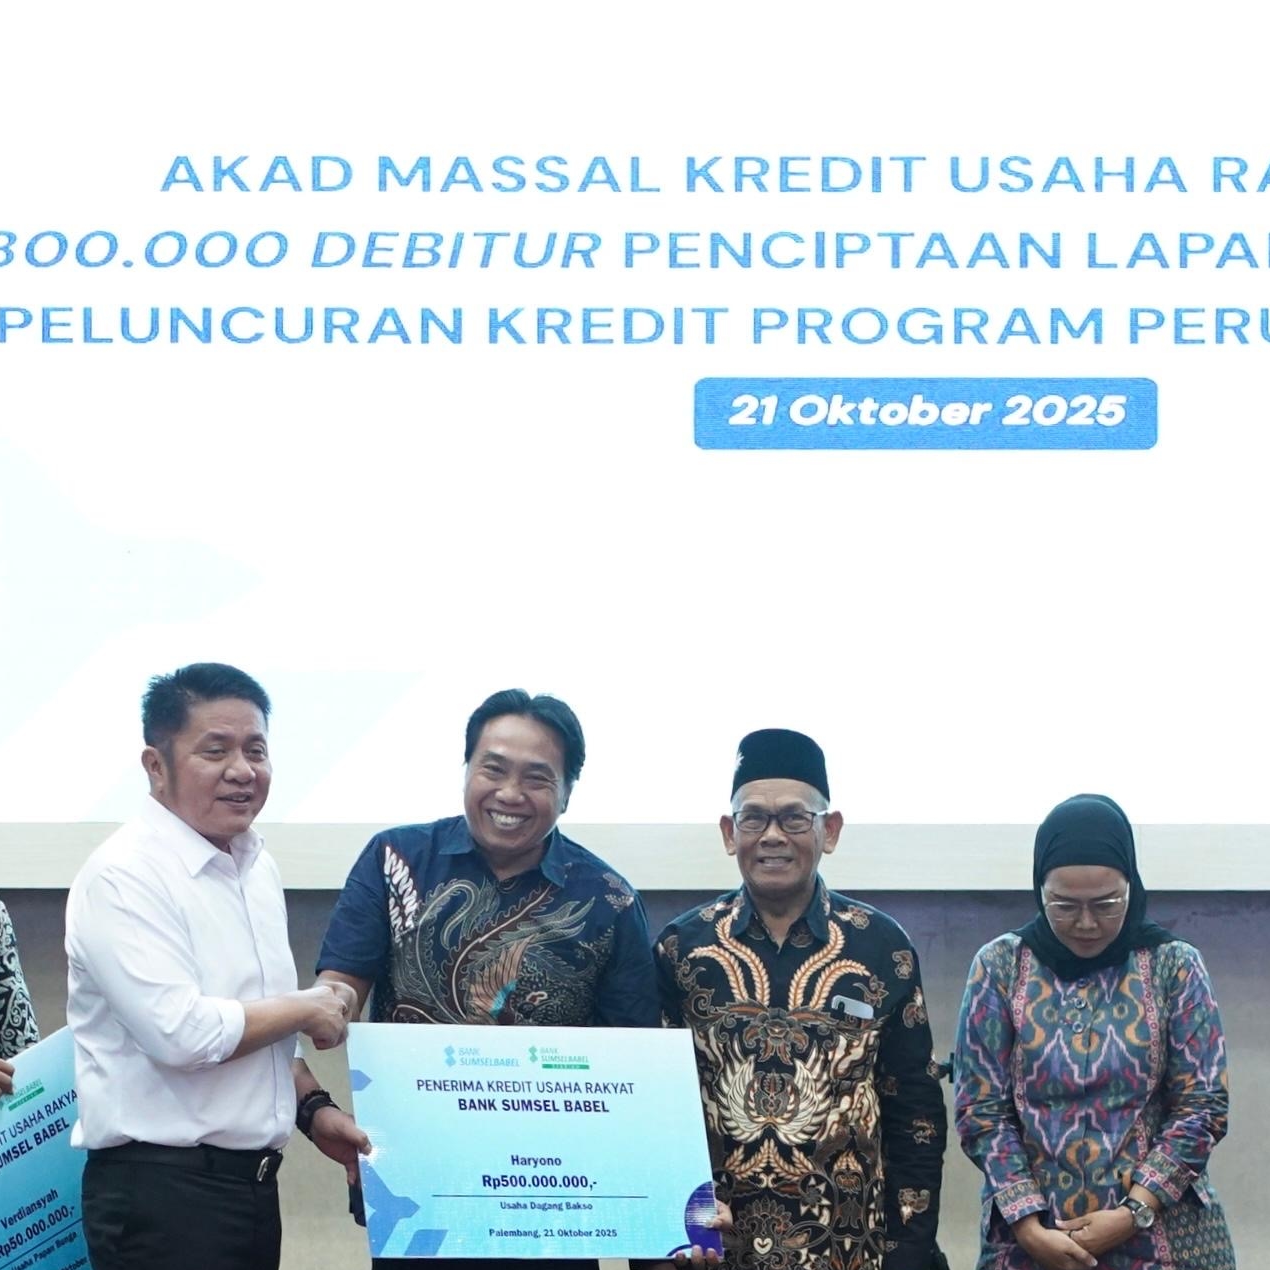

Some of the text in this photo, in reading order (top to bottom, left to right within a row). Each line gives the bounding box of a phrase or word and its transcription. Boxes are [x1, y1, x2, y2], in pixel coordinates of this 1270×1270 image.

[159, 155, 354, 194] AKAD
[376, 155, 662, 194] MASSAL
[685, 155, 928, 194] KREDIT
[949, 155, 1189, 194] USAHA
[309, 230, 603, 270] DEBITUR
[623, 230, 1062, 270] PENCIPTAAN
[487, 306, 730, 346] KREDIT
[751, 306, 1105, 346] PROGRAM
[728, 393, 1128, 427] 21 Oktober 2025
[416, 1079, 635, 1095] PENERIMA KREDIT USAHA RAKYAT
[9, 1109, 45, 1139] USAHA
[44, 1088, 78, 1117] RAKYA
[457, 1098, 610, 1113] BANK SUMSEL BABEL
[33, 1117, 70, 1147] BABEL
[510, 1155, 563, 1168] Haryono
[481, 1174, 598, 1191] Rp500.000.000,-
[0, 1188, 59, 1230] Verdiansyah
[500, 1201, 593, 1211] Usaha Dagang Bakso
[489, 1228, 618, 1238] Palembang, 21 Oktober 2025
